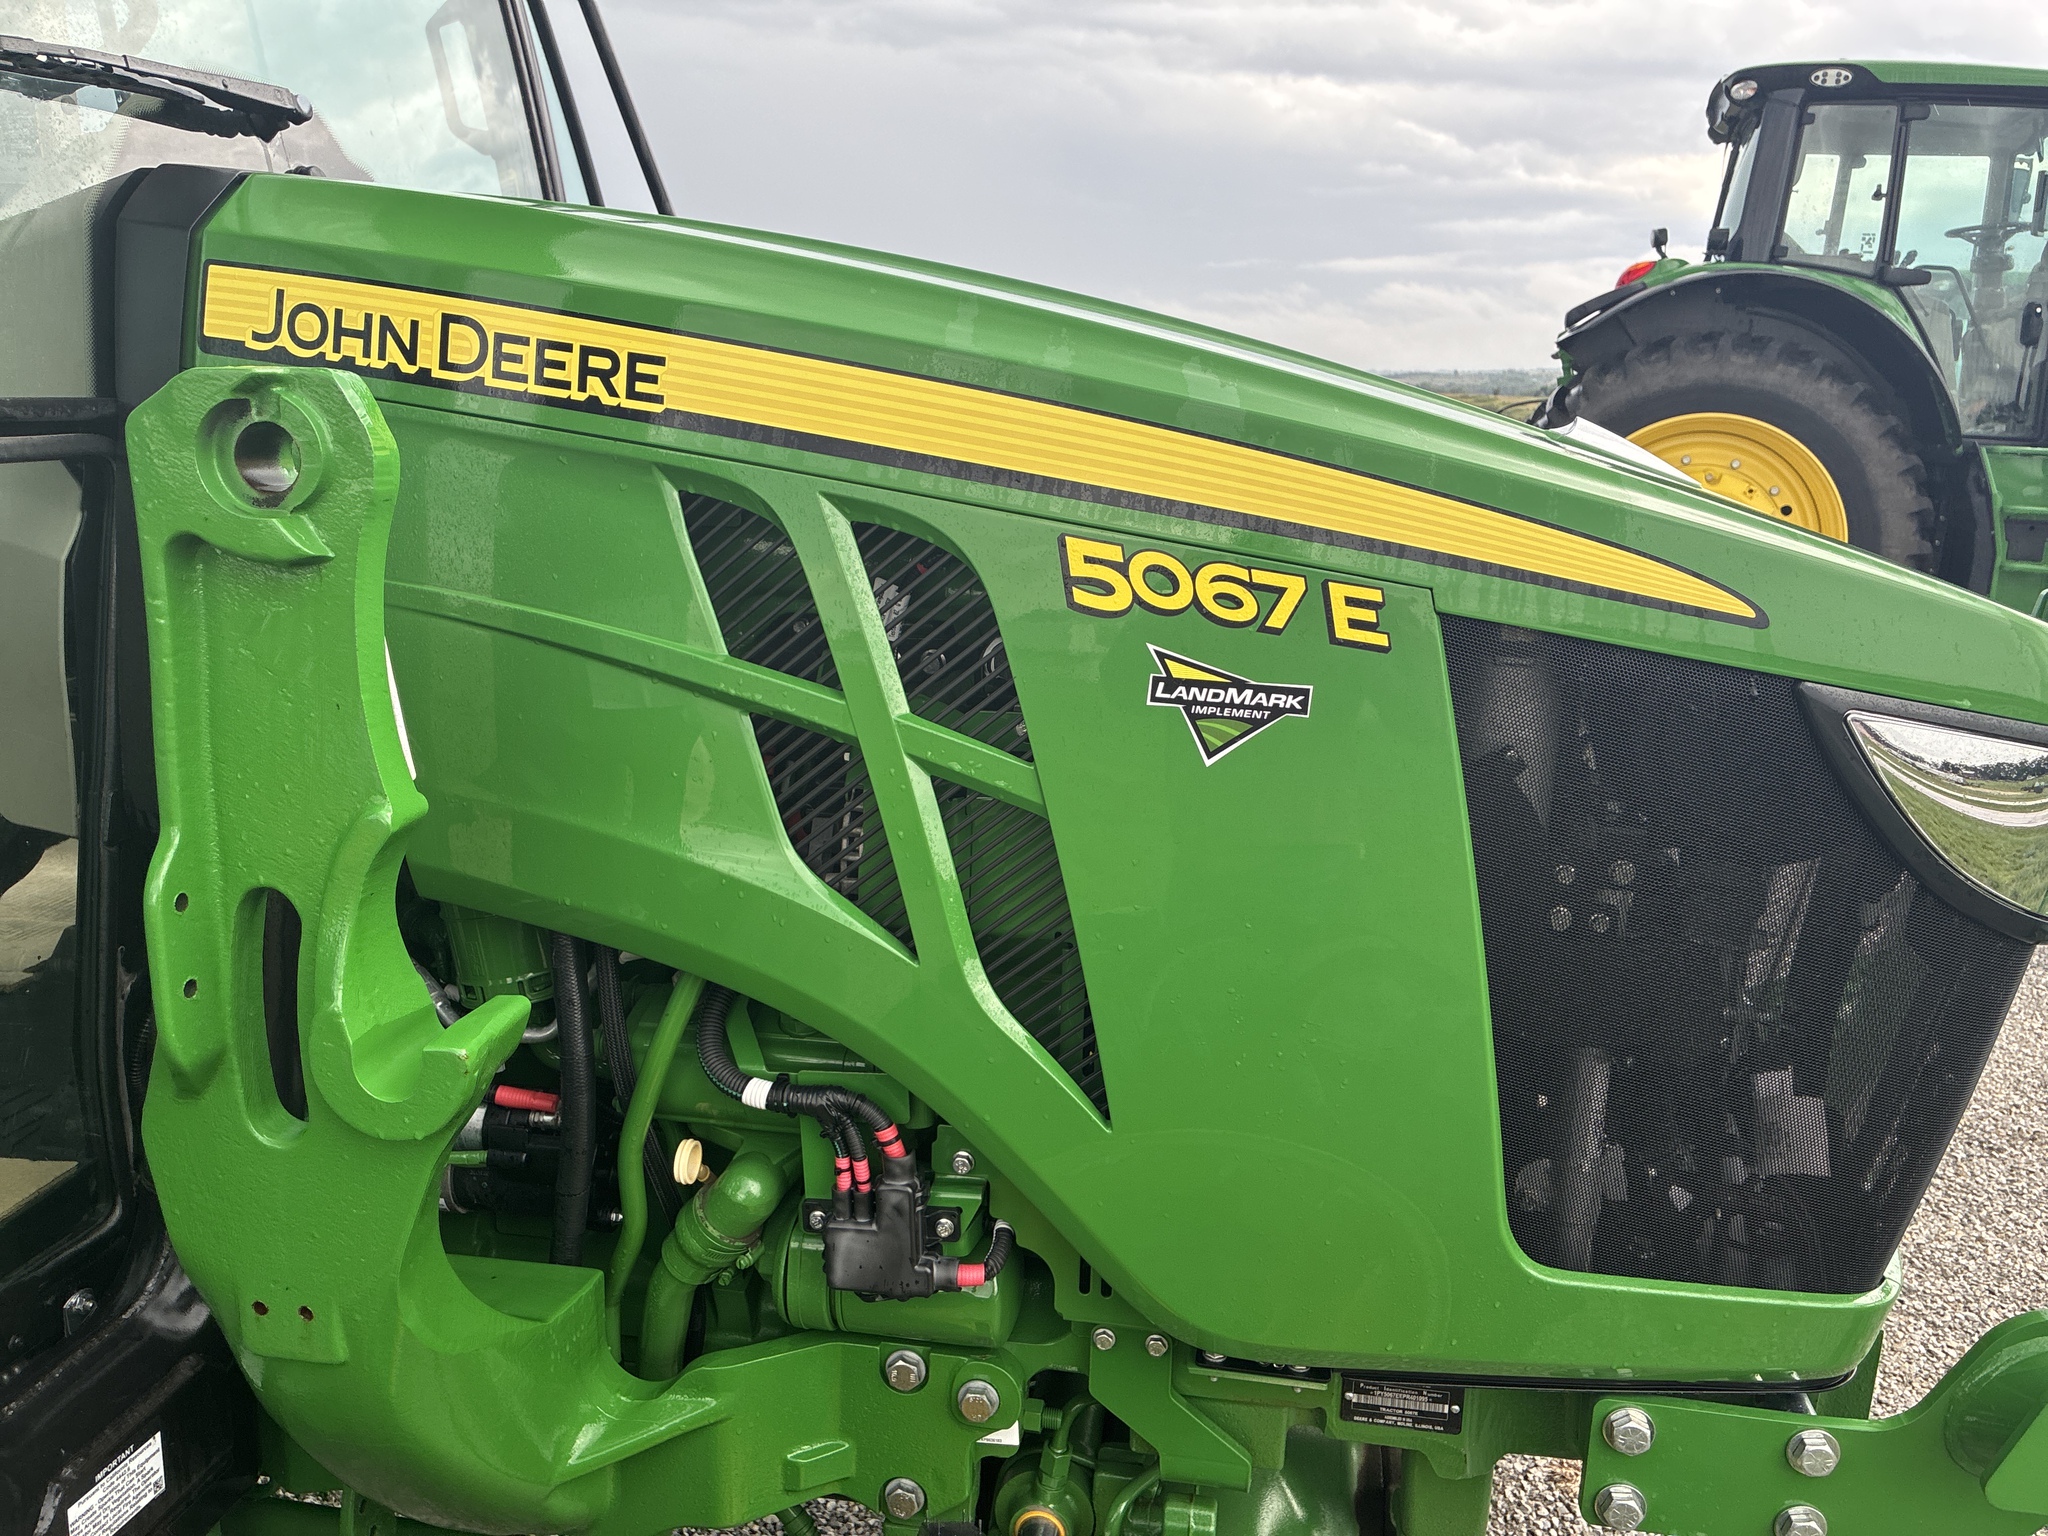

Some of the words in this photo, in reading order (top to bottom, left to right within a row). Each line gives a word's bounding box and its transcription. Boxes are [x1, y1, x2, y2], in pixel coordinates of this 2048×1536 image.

[249, 288, 420, 370] JOHN
[433, 312, 666, 408] DEERE
[1058, 533, 1308, 636] 5067
[1321, 578, 1392, 654] E
[1154, 681, 1306, 710] LANDMARK
[1190, 705, 1271, 720] IMPLEMENT
[1359, 1382, 1379, 1391] Product
[1383, 1385, 1419, 1396] Identification
[1422, 1390, 1443, 1398] Number
[1379, 1407, 1403, 1415] TRACTOR
[77, 1485, 100, 1508] Pursuant
[105, 1461, 128, 1484] California
[128, 1440, 152, 1465] Resources
[95, 1443, 135, 1483] IMPORTANT
[68, 1504, 94, 1530] WARNING
[97, 1481, 120, 1505] Operation
[126, 1467, 136, 1479] This
[136, 1446, 160, 1471] Equipment
[102, 1479, 115, 1494] Code
[81, 1508, 97, 1526] Create
[114, 1484, 125, 1497] That
[84, 1511, 101, 1530] Around
